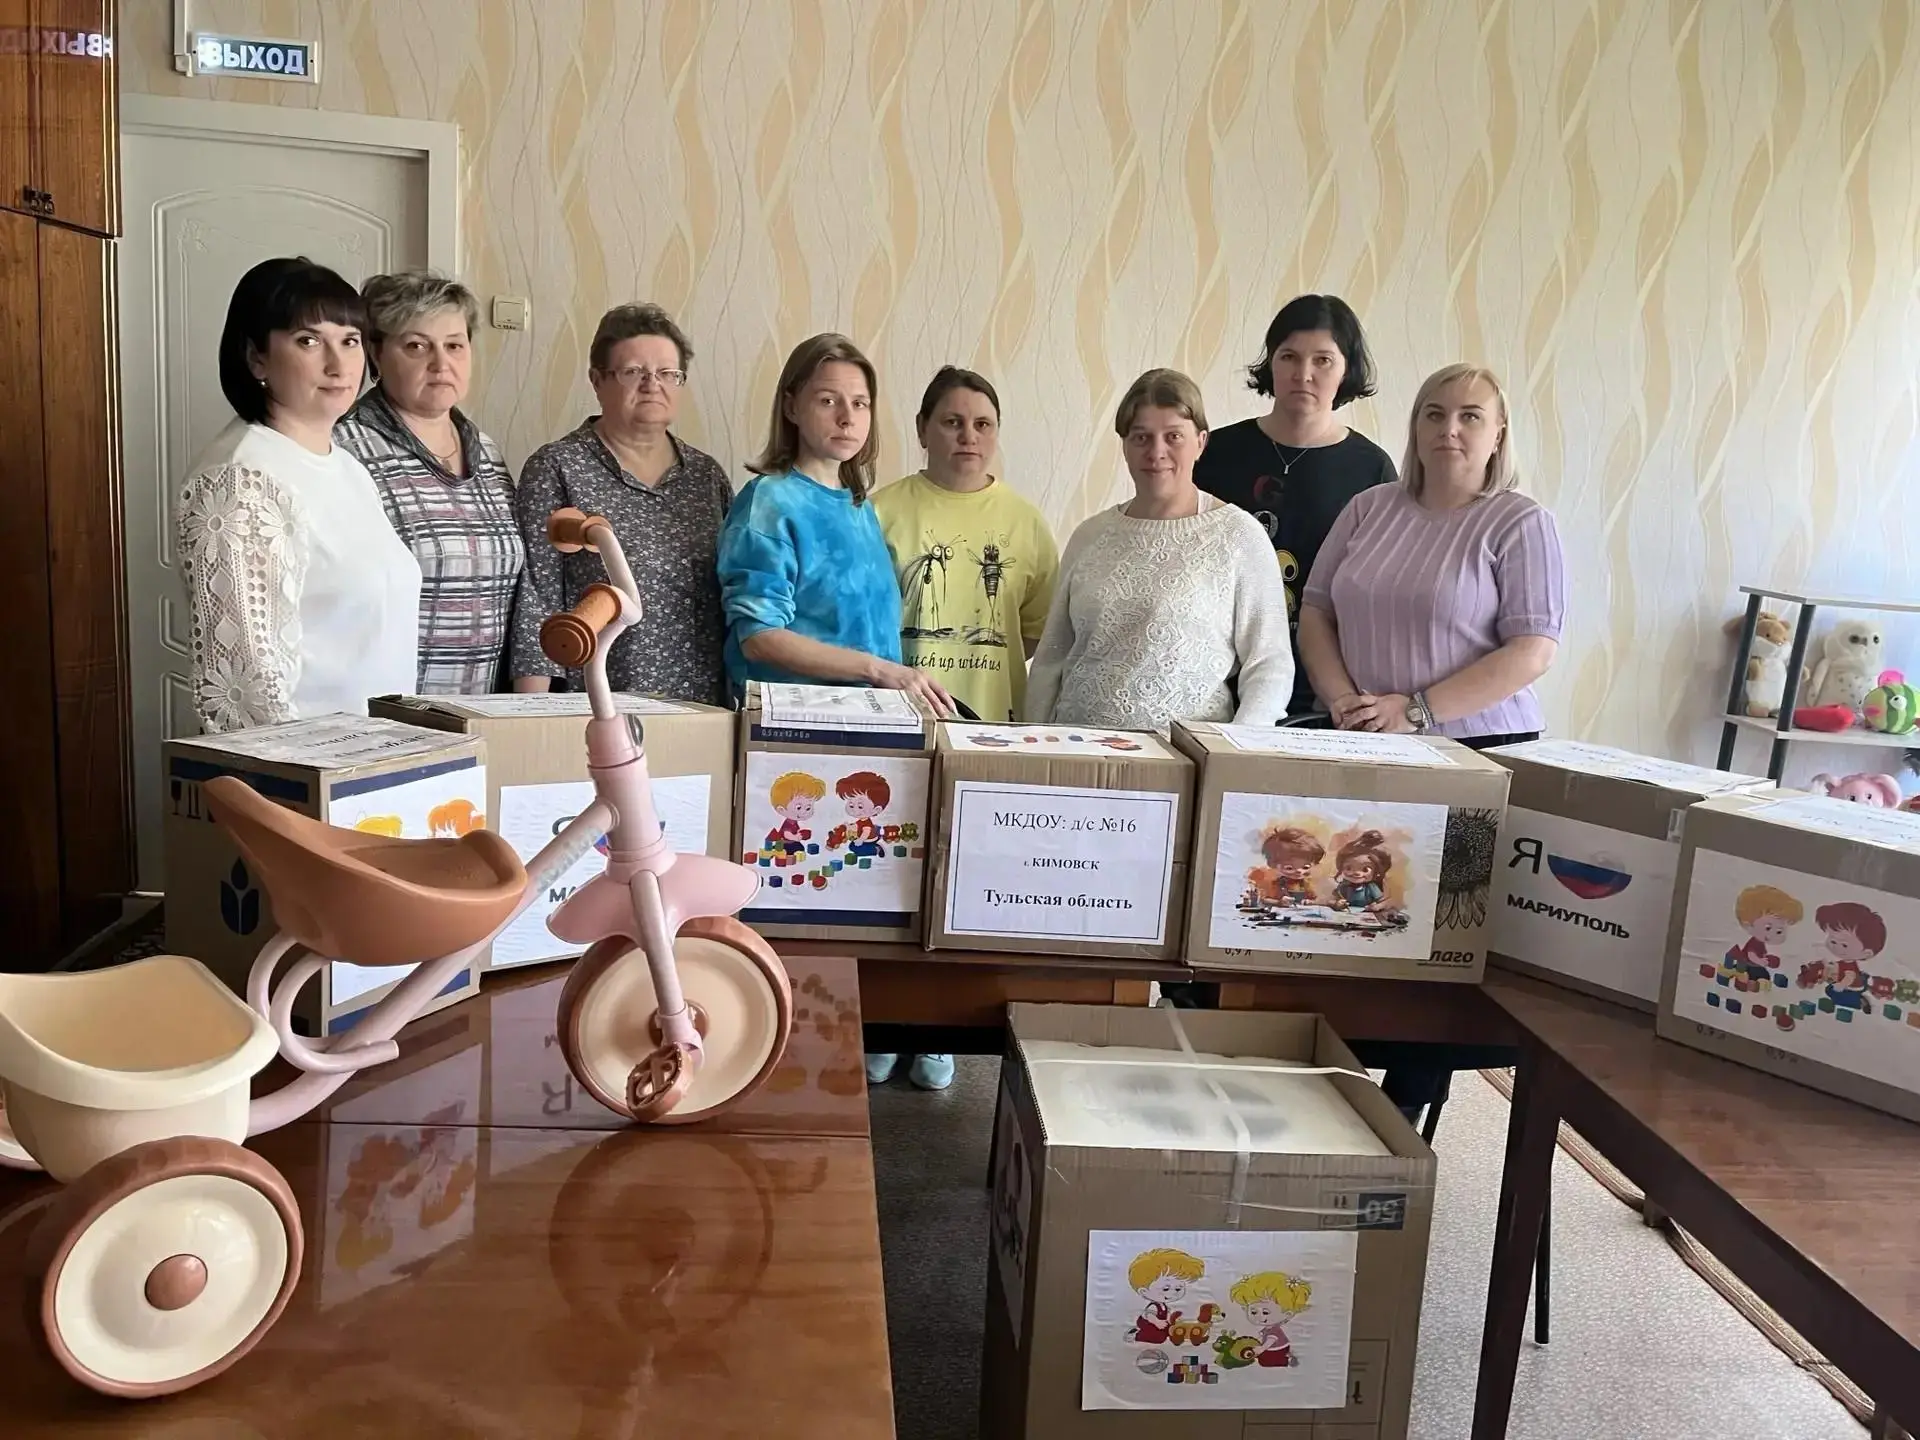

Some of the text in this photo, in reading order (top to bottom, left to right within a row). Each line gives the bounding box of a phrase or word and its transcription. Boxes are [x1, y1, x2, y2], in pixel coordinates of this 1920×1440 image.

[203, 39, 304, 74] ВЫХОД
[939, 657, 954, 672] up
[993, 812, 1137, 833] МКДОУ: д/с №16
[1032, 857, 1100, 870] КИМОВСК
[1508, 837, 1543, 875] Я
[984, 888, 1133, 909] Тульская область
[1507, 893, 1630, 939] МАРИУПОЛЬ
